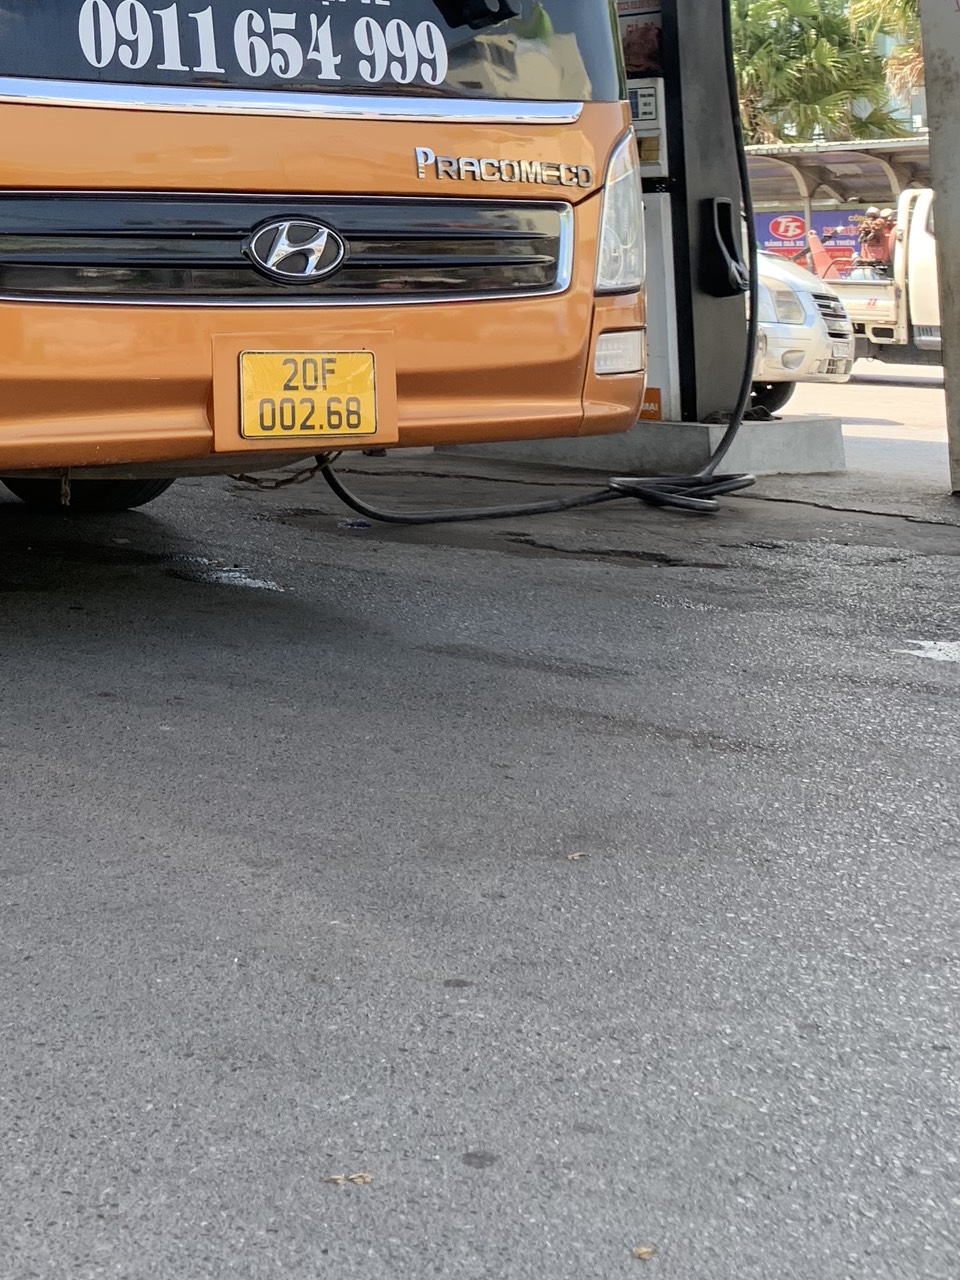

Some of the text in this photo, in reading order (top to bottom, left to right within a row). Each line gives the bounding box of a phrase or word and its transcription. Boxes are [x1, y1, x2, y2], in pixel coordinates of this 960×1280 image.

[233, 8, 341, 80] 654
[354, 16, 448, 85] 999
[415, 147, 594, 188] PRACOMECO
[281, 357, 337, 391] 20F
[259, 397, 361, 431] 002.68
